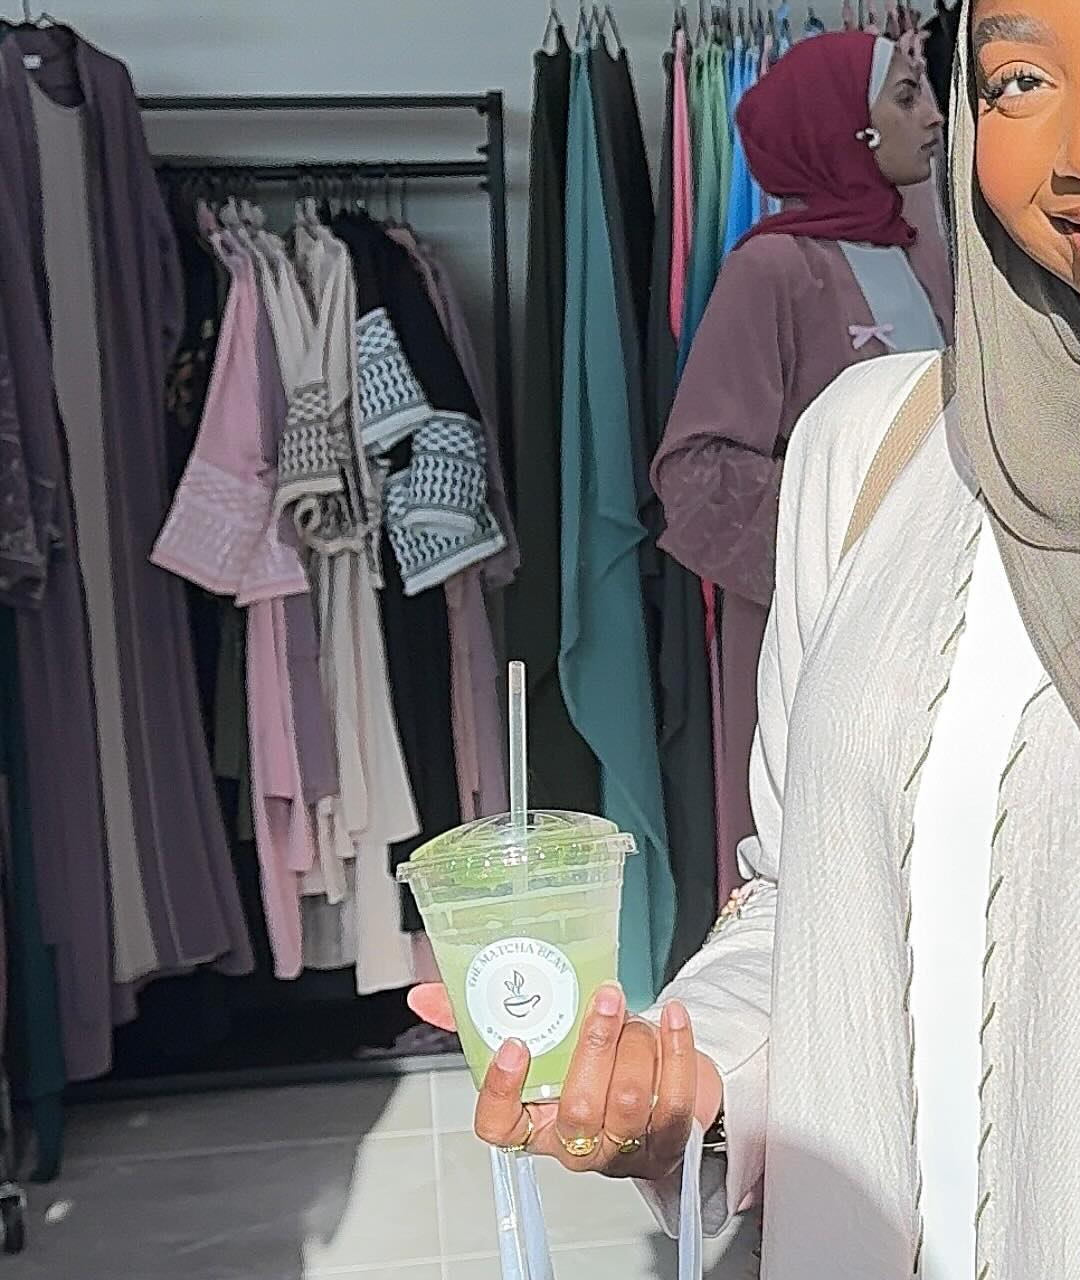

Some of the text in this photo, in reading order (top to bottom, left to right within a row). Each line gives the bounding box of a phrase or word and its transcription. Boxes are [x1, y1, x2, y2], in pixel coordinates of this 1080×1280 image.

[468, 942, 570, 987] THE MATCHA BEAN
